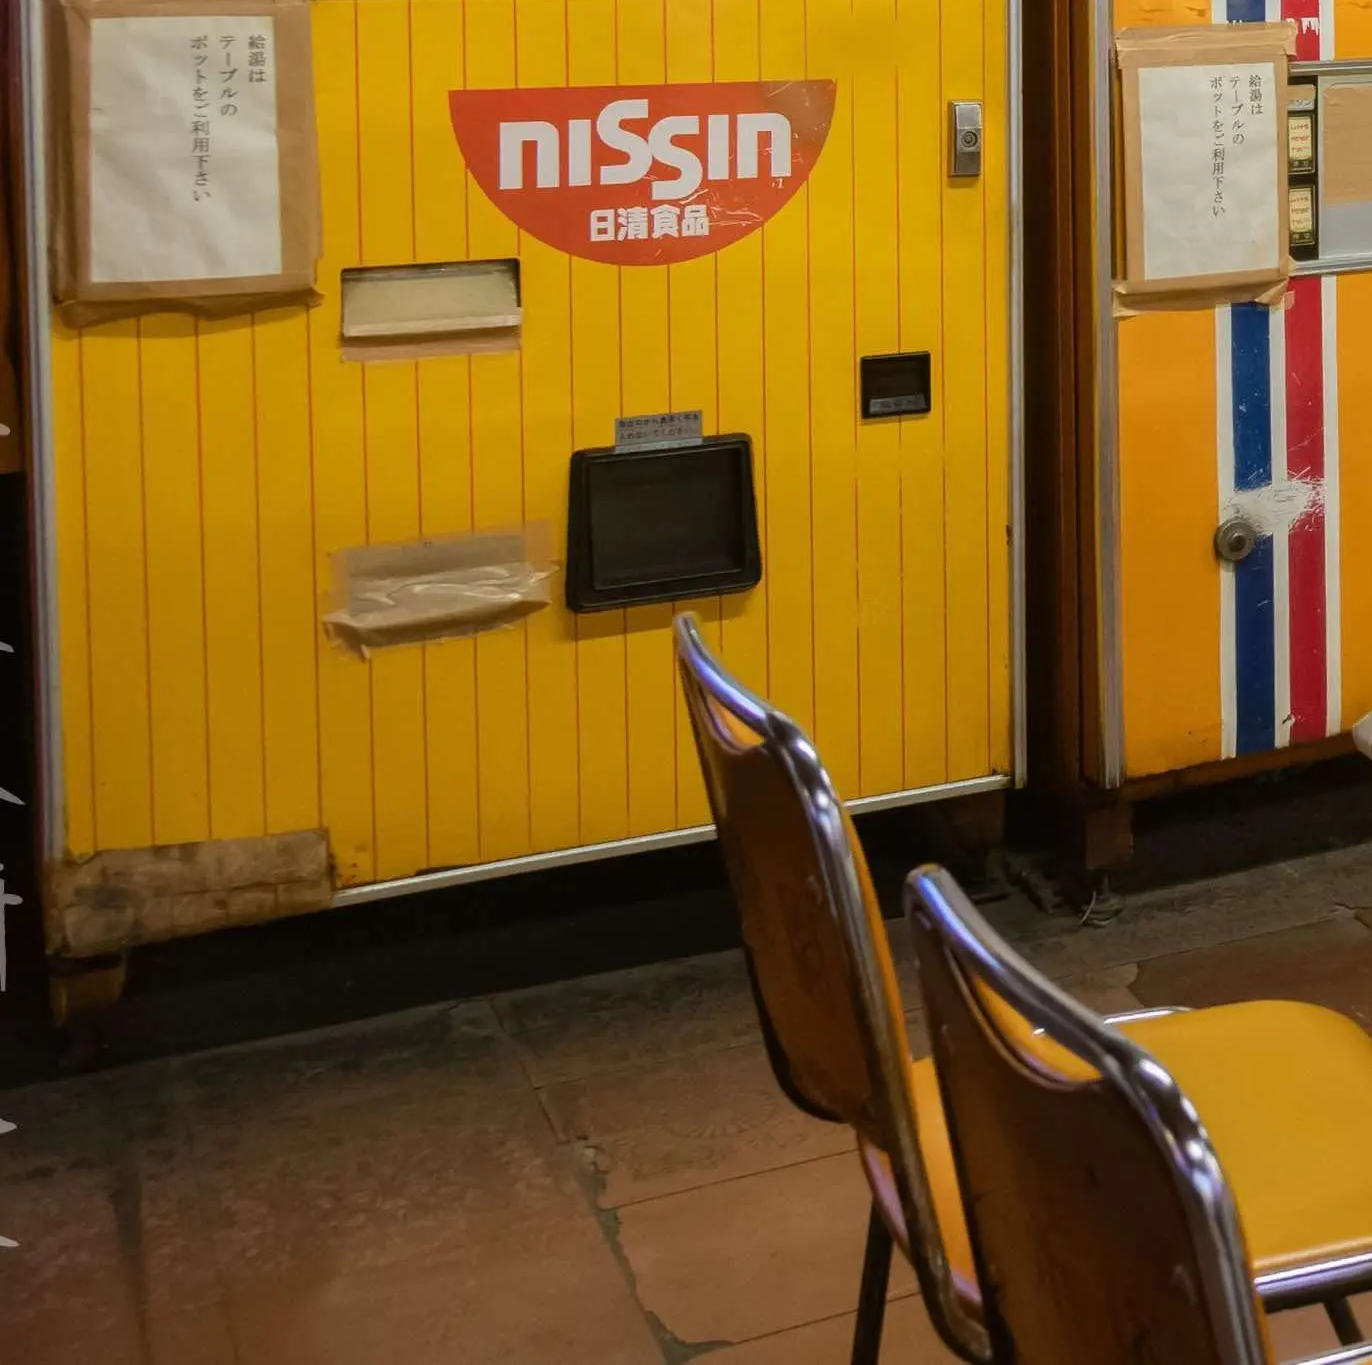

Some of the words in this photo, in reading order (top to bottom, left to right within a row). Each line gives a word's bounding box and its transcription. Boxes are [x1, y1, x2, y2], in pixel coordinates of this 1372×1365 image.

[1229, 75, 1245, 146] テーブルの
[1249, 73, 1264, 116] 給湯は
[1210, 74, 1227, 218] ポットをご利用下さい
[589, 203, 710, 243] 日清食品
